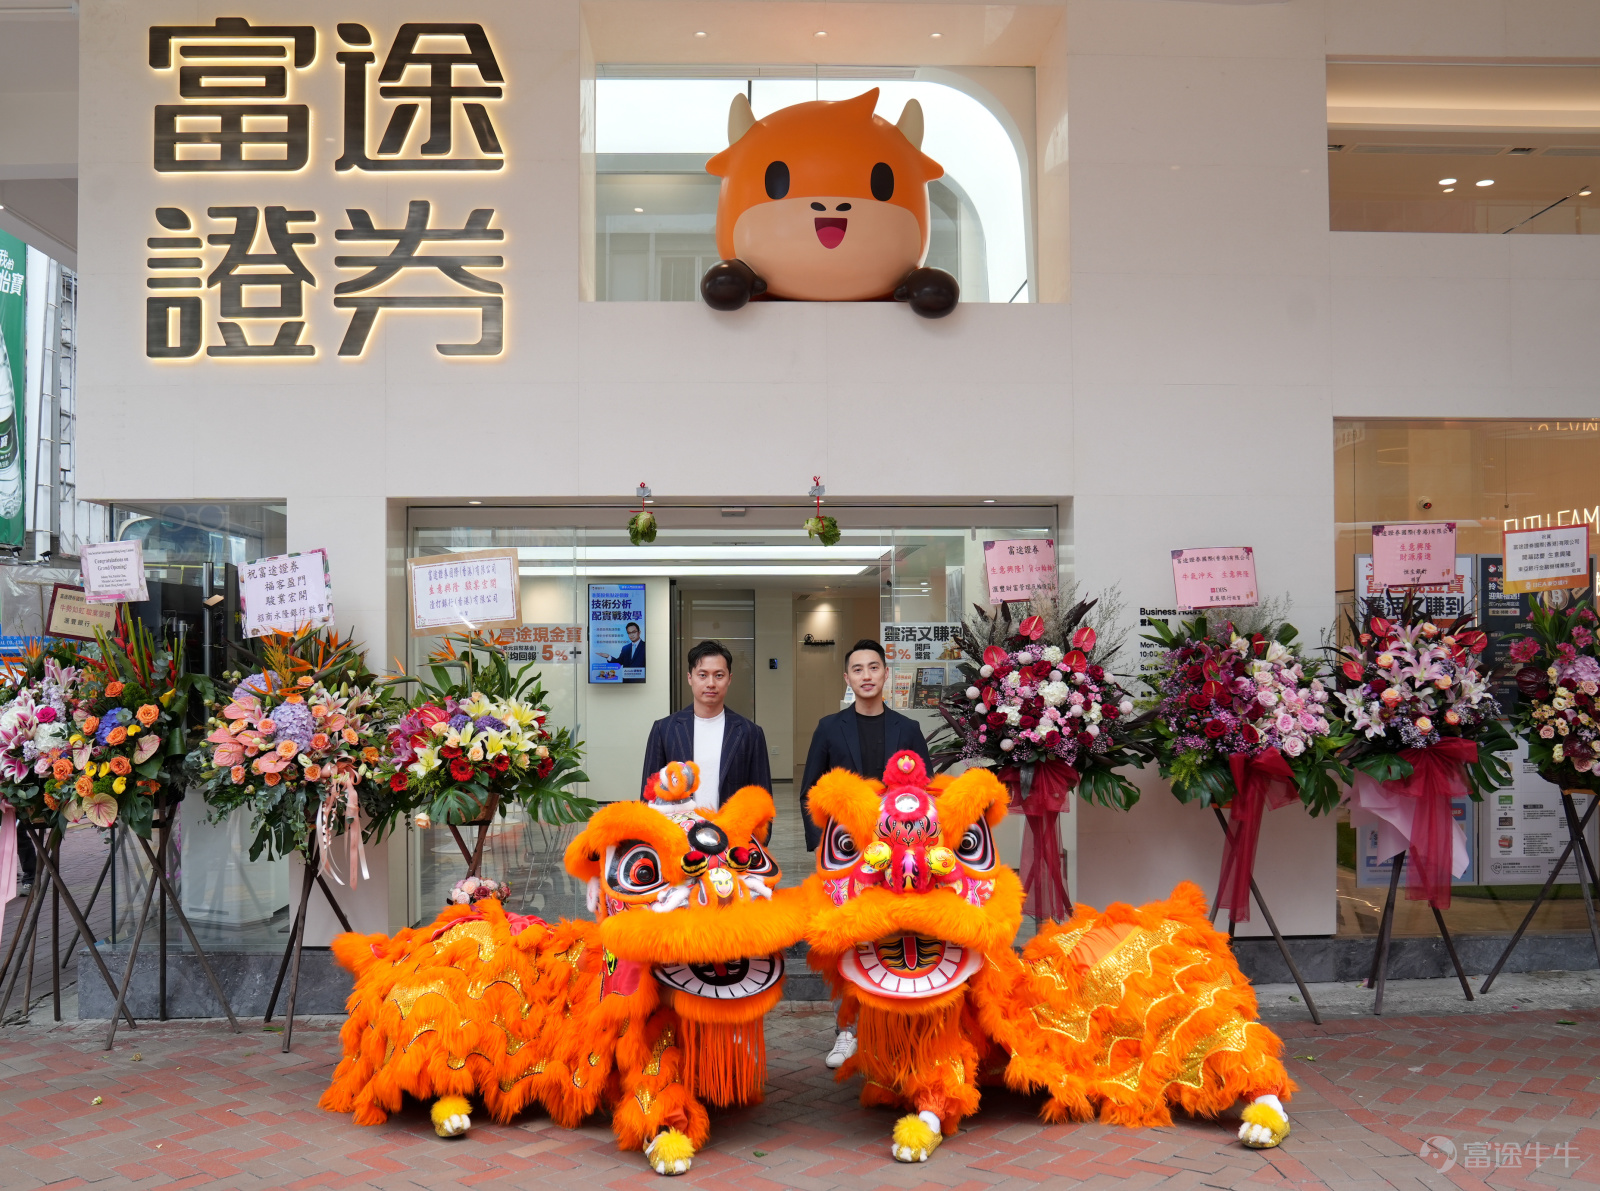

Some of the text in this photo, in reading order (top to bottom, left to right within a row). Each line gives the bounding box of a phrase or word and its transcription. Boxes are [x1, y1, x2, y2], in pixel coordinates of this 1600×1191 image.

[148, 17, 505, 172] 富途
[146, 200, 505, 358] 證券
[247, 560, 299, 579] 祝富途證券
[592, 600, 632, 609] 技術分析
[1140, 608, 1177, 616] Business
[885, 644, 911, 660] 5%
